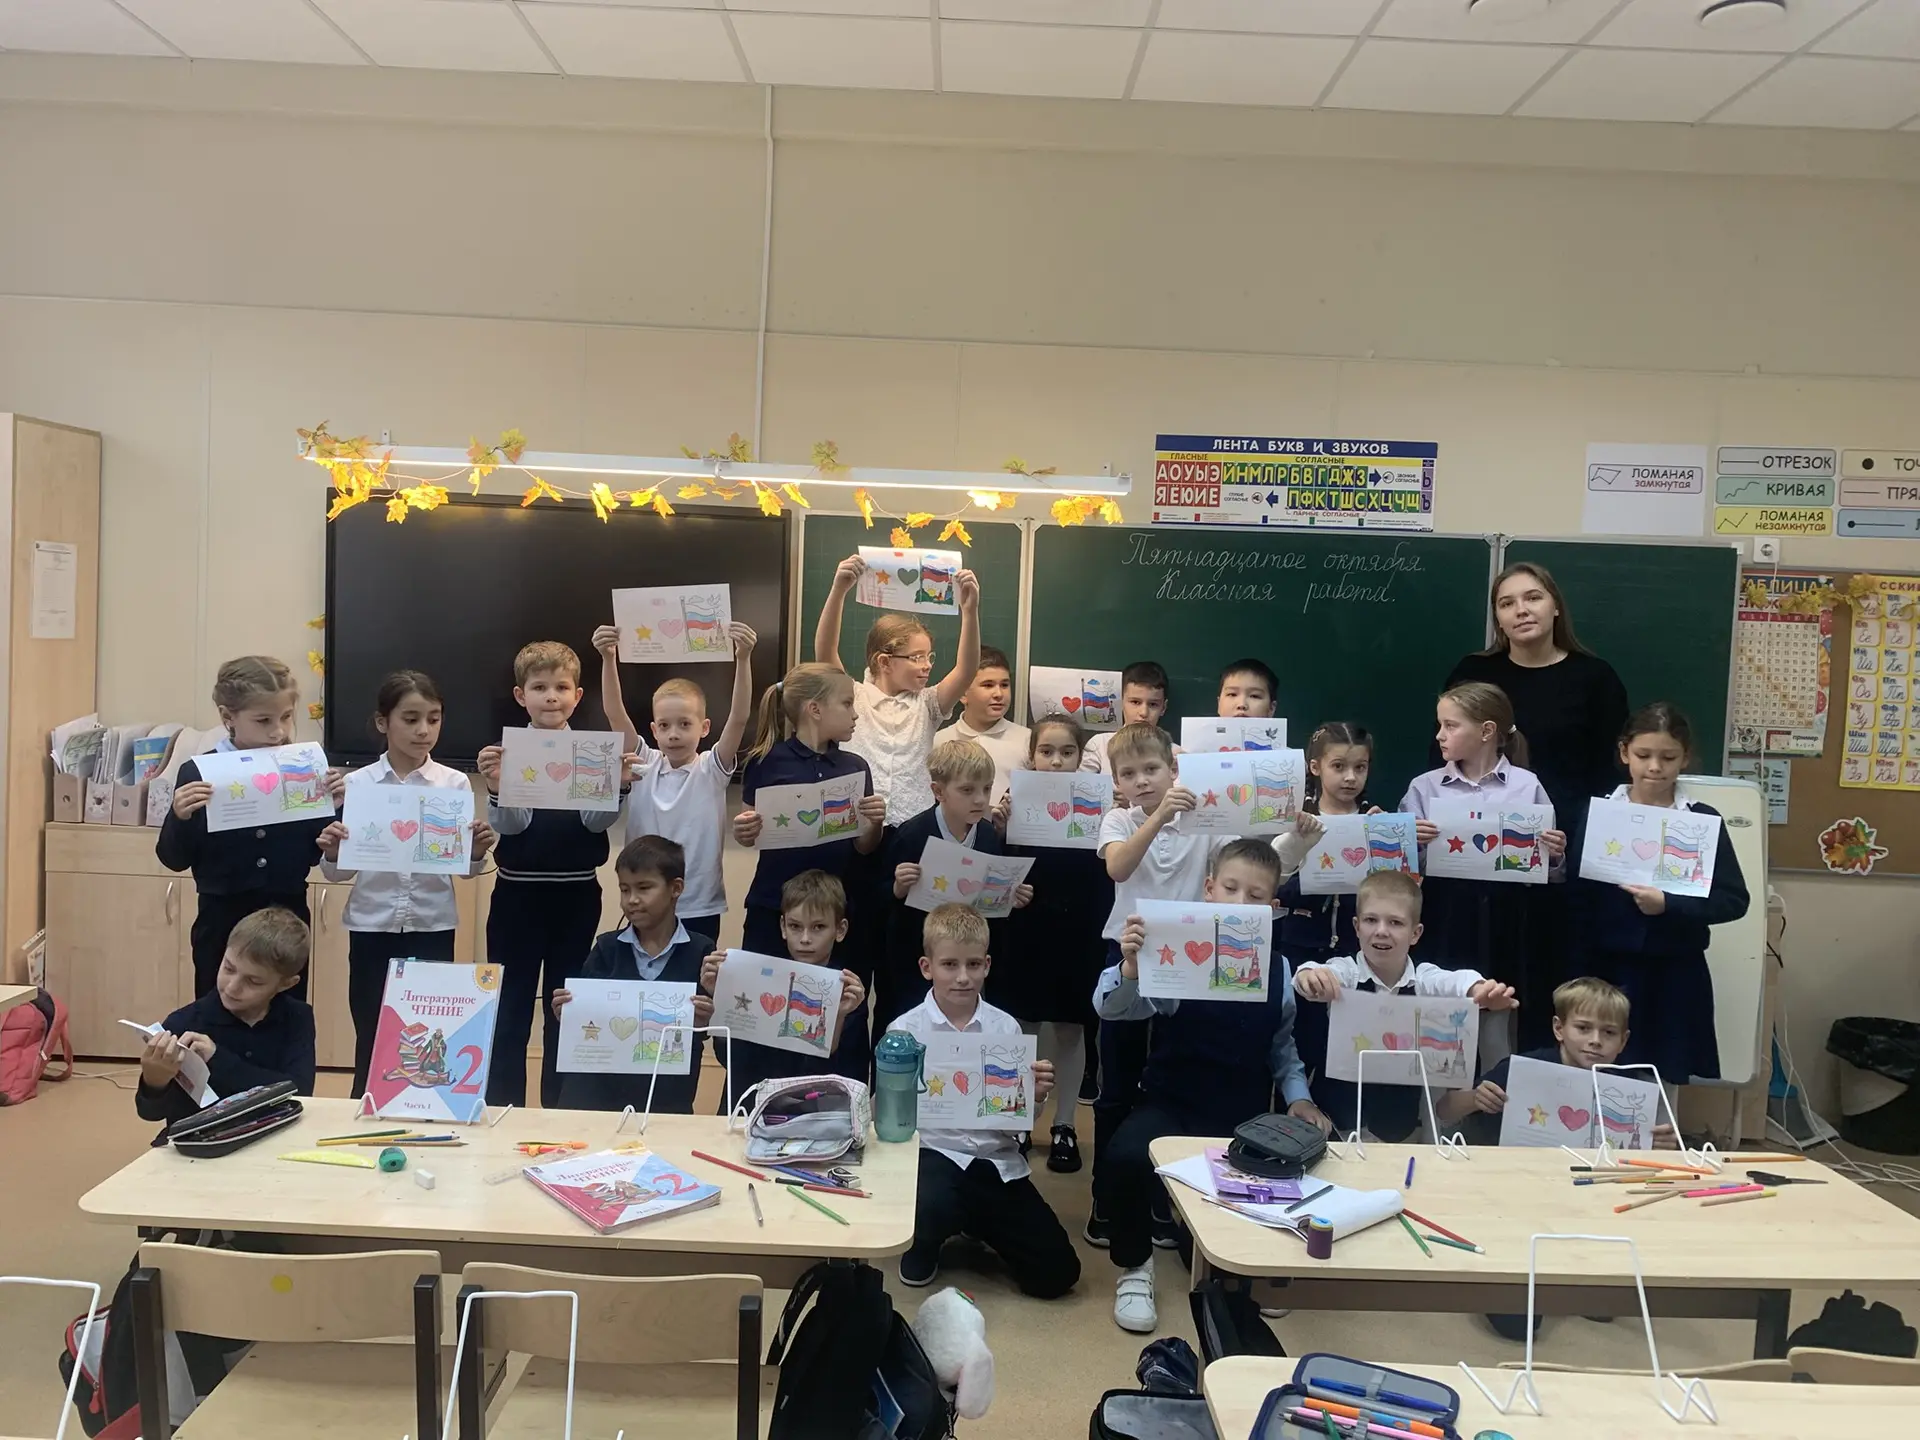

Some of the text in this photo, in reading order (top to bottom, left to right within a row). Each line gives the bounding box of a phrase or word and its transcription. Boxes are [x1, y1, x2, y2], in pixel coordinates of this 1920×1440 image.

[1213, 439, 1390, 454] ЛЕНТА БУКВ И ЗВУКОВ
[1295, 456, 1346, 464] СОГЛАСНЫЕ
[1762, 455, 1832, 469] ОТРЕЗОК
[1631, 468, 1695, 480] ЛОМАНАЯ
[1635, 480, 1691, 491] замкнутая
[1766, 483, 1826, 497] КРИВАЯ
[1760, 510, 1824, 522] ЛОМАНАЯ
[1755, 522, 1826, 533] незамкнутая
[1121, 532, 1426, 588] Пятнадцатое октября.
[1156, 568, 1395, 614] Классная работа.
[400, 989, 477, 1006] Литературное
[411, 1004, 464, 1017] ЧТЕНИЕ
[451, 1045, 484, 1095] 2
[653, 1173, 700, 1196] 2
